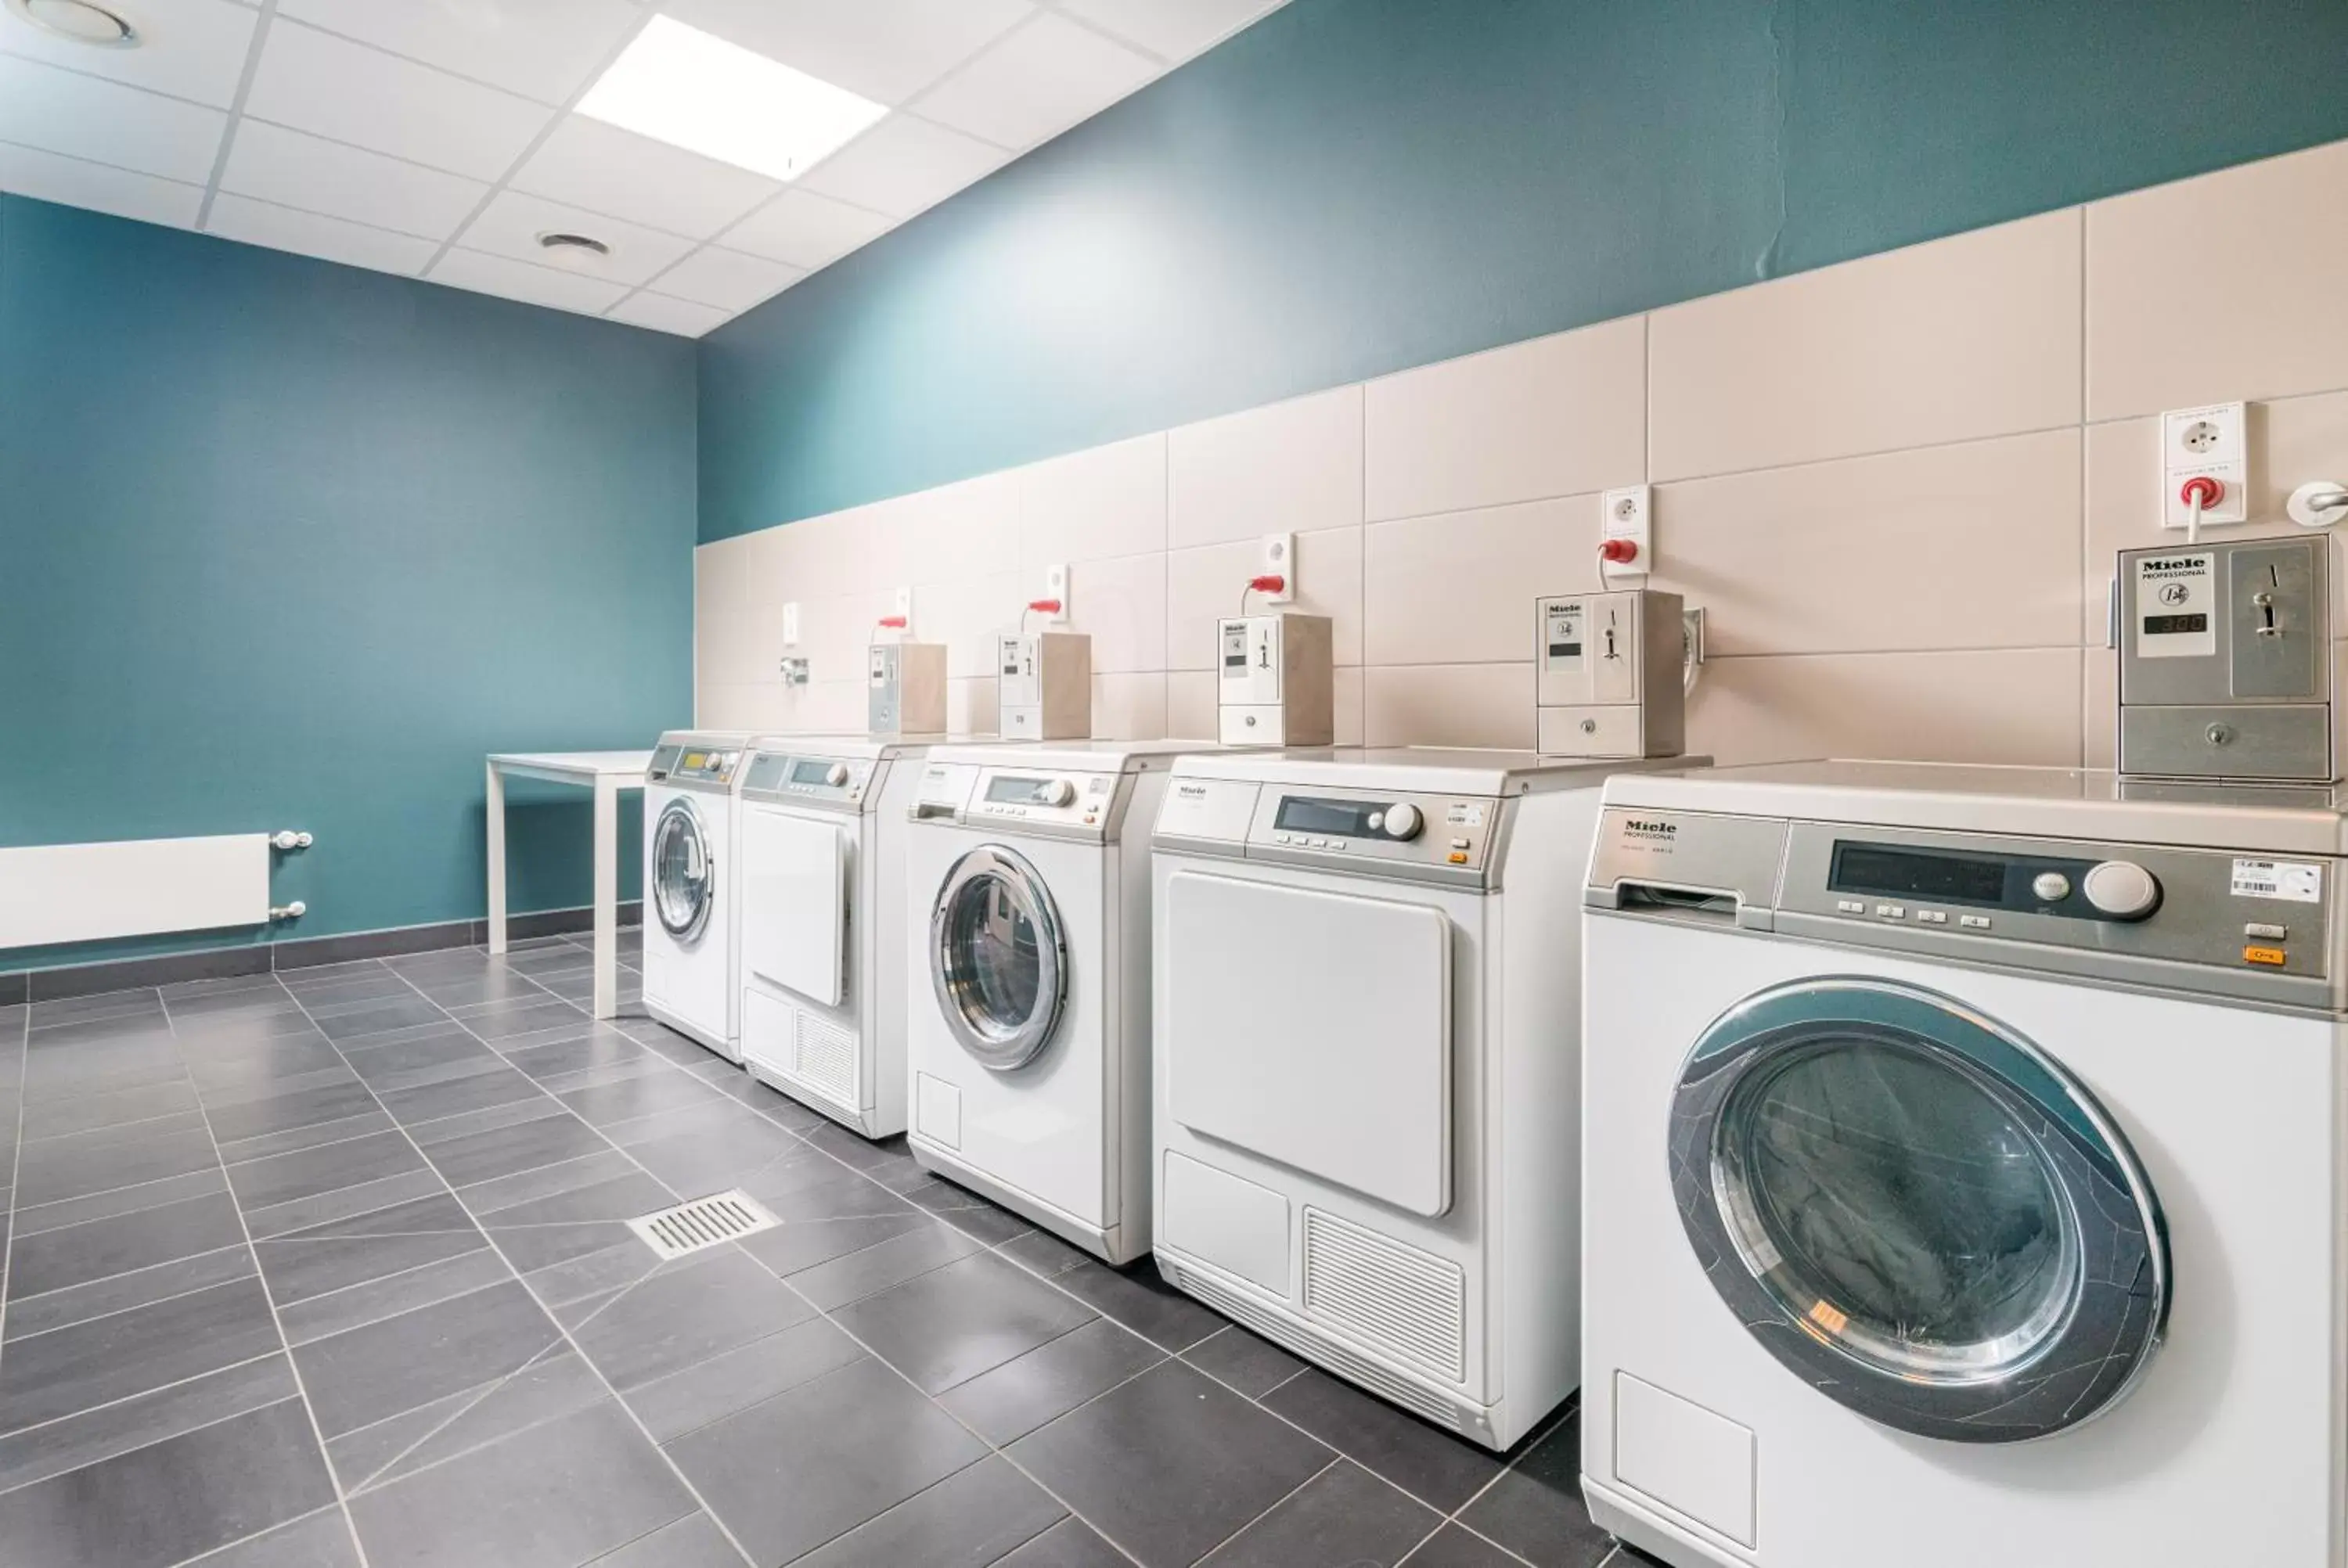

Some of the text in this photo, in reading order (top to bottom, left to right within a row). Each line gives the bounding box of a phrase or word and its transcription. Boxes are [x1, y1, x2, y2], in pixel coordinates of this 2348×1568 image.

[2142, 558, 2206, 572] Miele
[2141, 569, 2208, 581] PROFESSIONAL
[1625, 820, 1677, 833] Miele
[1623, 831, 1676, 842] PROFESSIONAL
